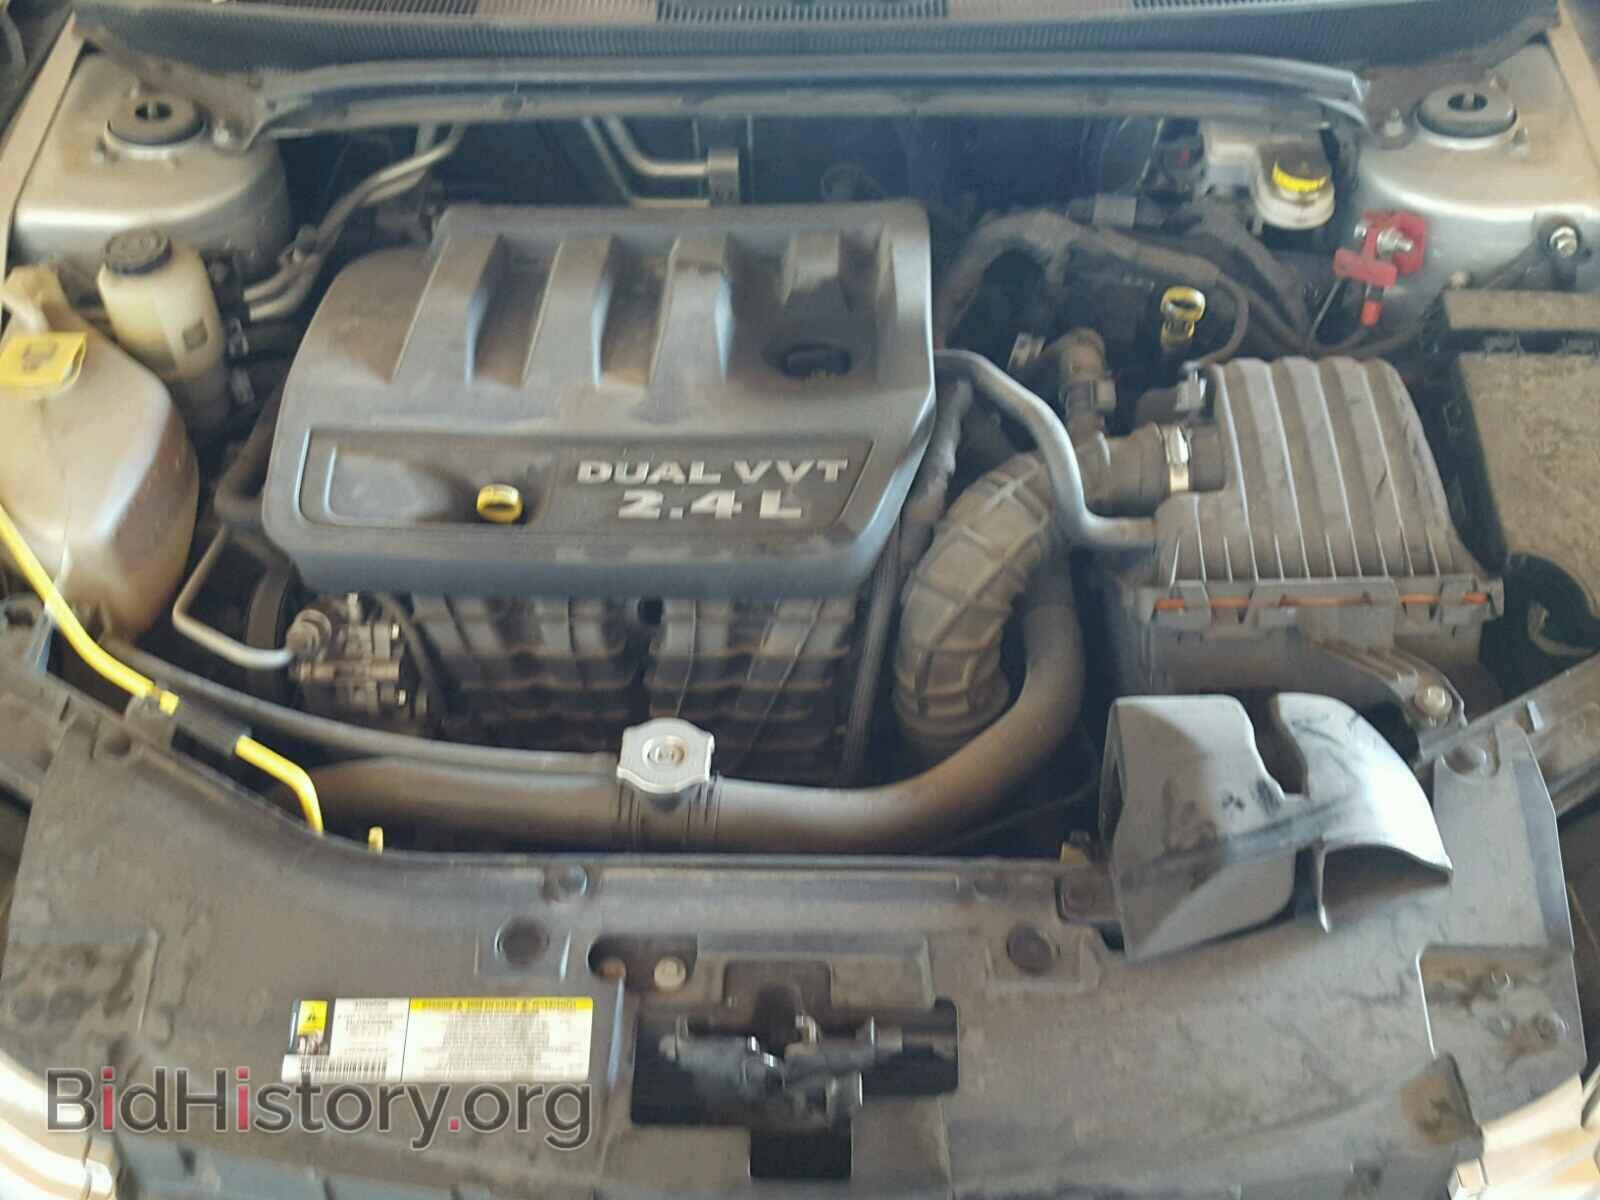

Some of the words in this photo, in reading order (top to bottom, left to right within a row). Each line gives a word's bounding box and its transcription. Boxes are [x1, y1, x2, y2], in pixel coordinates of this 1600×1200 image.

[577, 461, 721, 484] DUAL
[734, 460, 848, 483] VVT
[618, 490, 742, 519] 2.4
